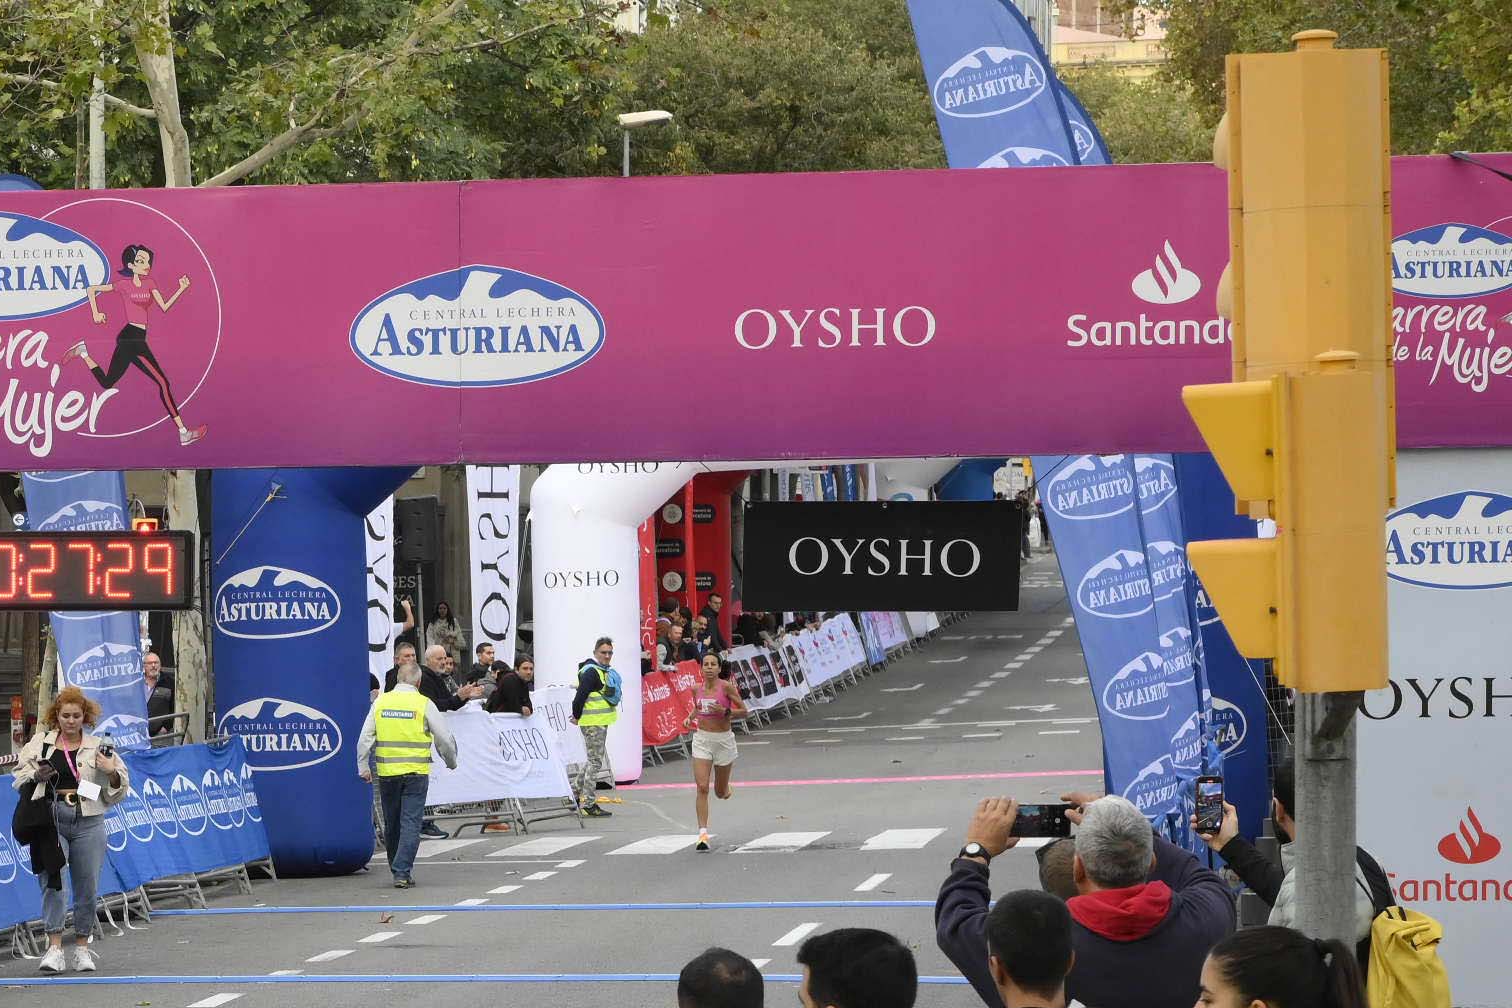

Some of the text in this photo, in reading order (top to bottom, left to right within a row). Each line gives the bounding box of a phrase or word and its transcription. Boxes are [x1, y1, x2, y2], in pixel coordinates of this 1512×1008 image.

[13, 248, 85, 259] LECHERA
[409, 306, 576, 320] CENTRAL LECHERA
[1392, 304, 1487, 332] arrera
[370, 312, 585, 356] ASTURIANA
[734, 305, 936, 350] OYSHO
[1066, 313, 1232, 347] Santand
[1416, 333, 1434, 361] la
[1429, 328, 1512, 392] Muje
[1413, 526, 1480, 536] CENTRAL
[789, 536, 980, 578] OYSHO
[1387, 530, 1512, 565] ASTURIA
[544, 569, 619, 588] OYSHO
[218, 595, 332, 623] ASTURIANA
[232, 590, 326, 600] CENTRAL LECHERA
[1358, 676, 1512, 720] OYSH
[224, 727, 332, 752] TURIANA
[233, 722, 327, 731] CENTRAL LECHERA
